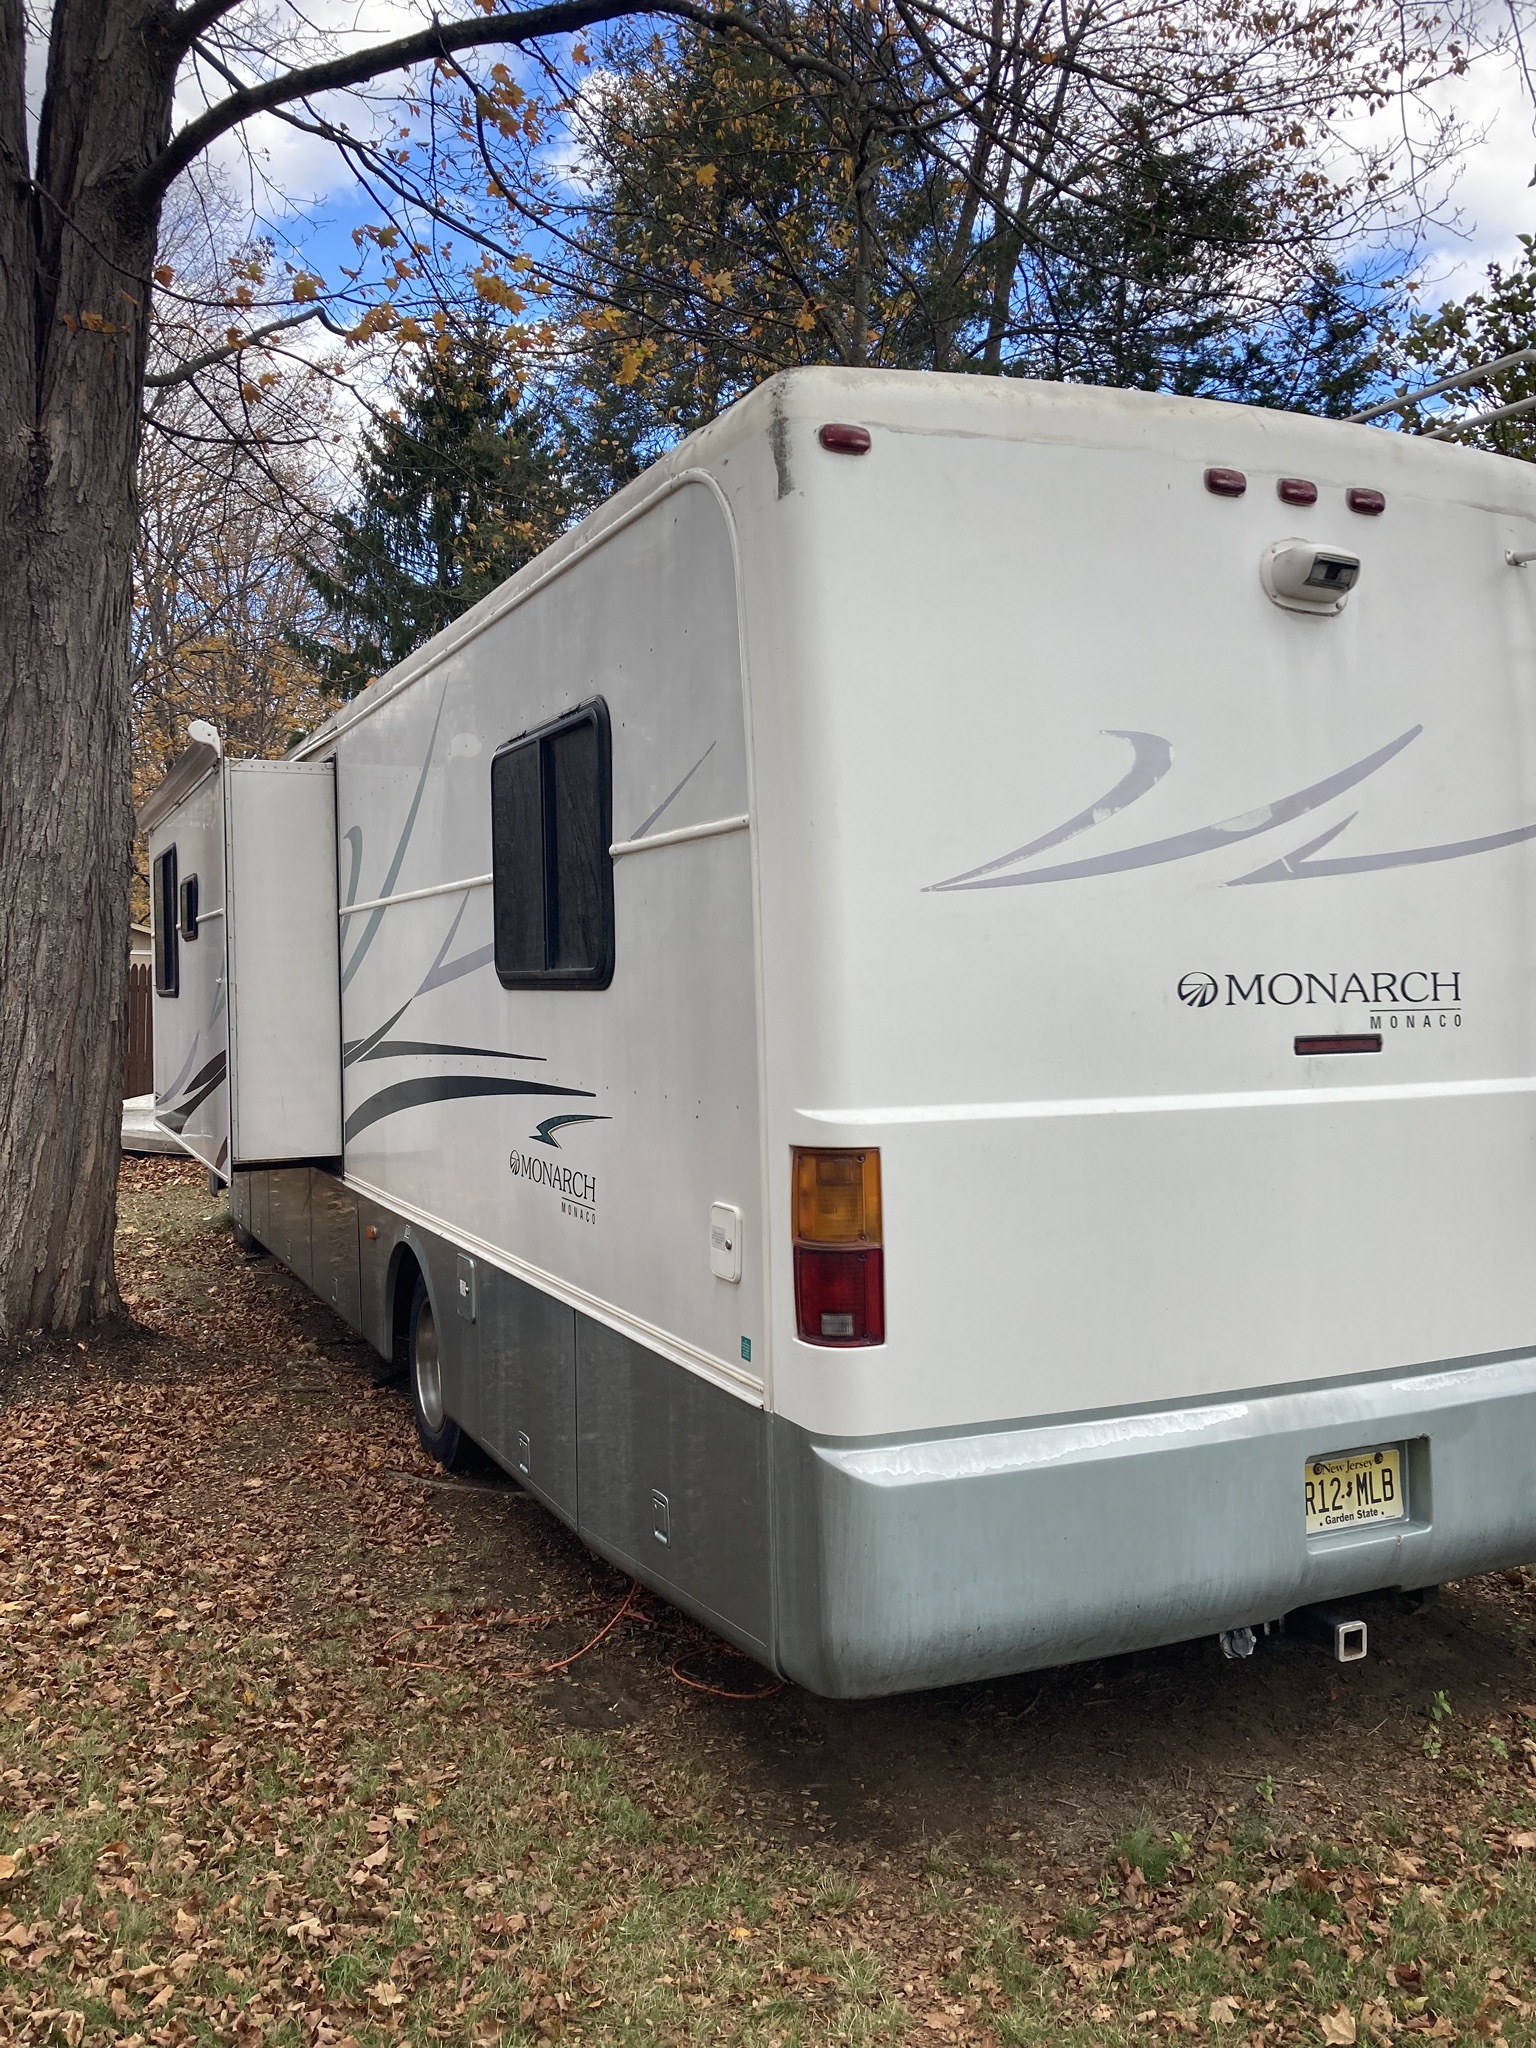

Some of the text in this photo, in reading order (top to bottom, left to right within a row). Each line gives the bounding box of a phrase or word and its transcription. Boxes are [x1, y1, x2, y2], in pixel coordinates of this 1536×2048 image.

[1225, 972, 1461, 1006] MONARCH
[1370, 1014, 1462, 1030] MONACO
[520, 1154, 596, 1203] MONARCH
[561, 1201, 596, 1225] MONACO
[1321, 1459, 1374, 1475] New Jersey
[1305, 1468, 1395, 1516] R12 MLB
[1325, 1512, 1355, 1525] Garden
[1357, 1508, 1378, 1519] State
